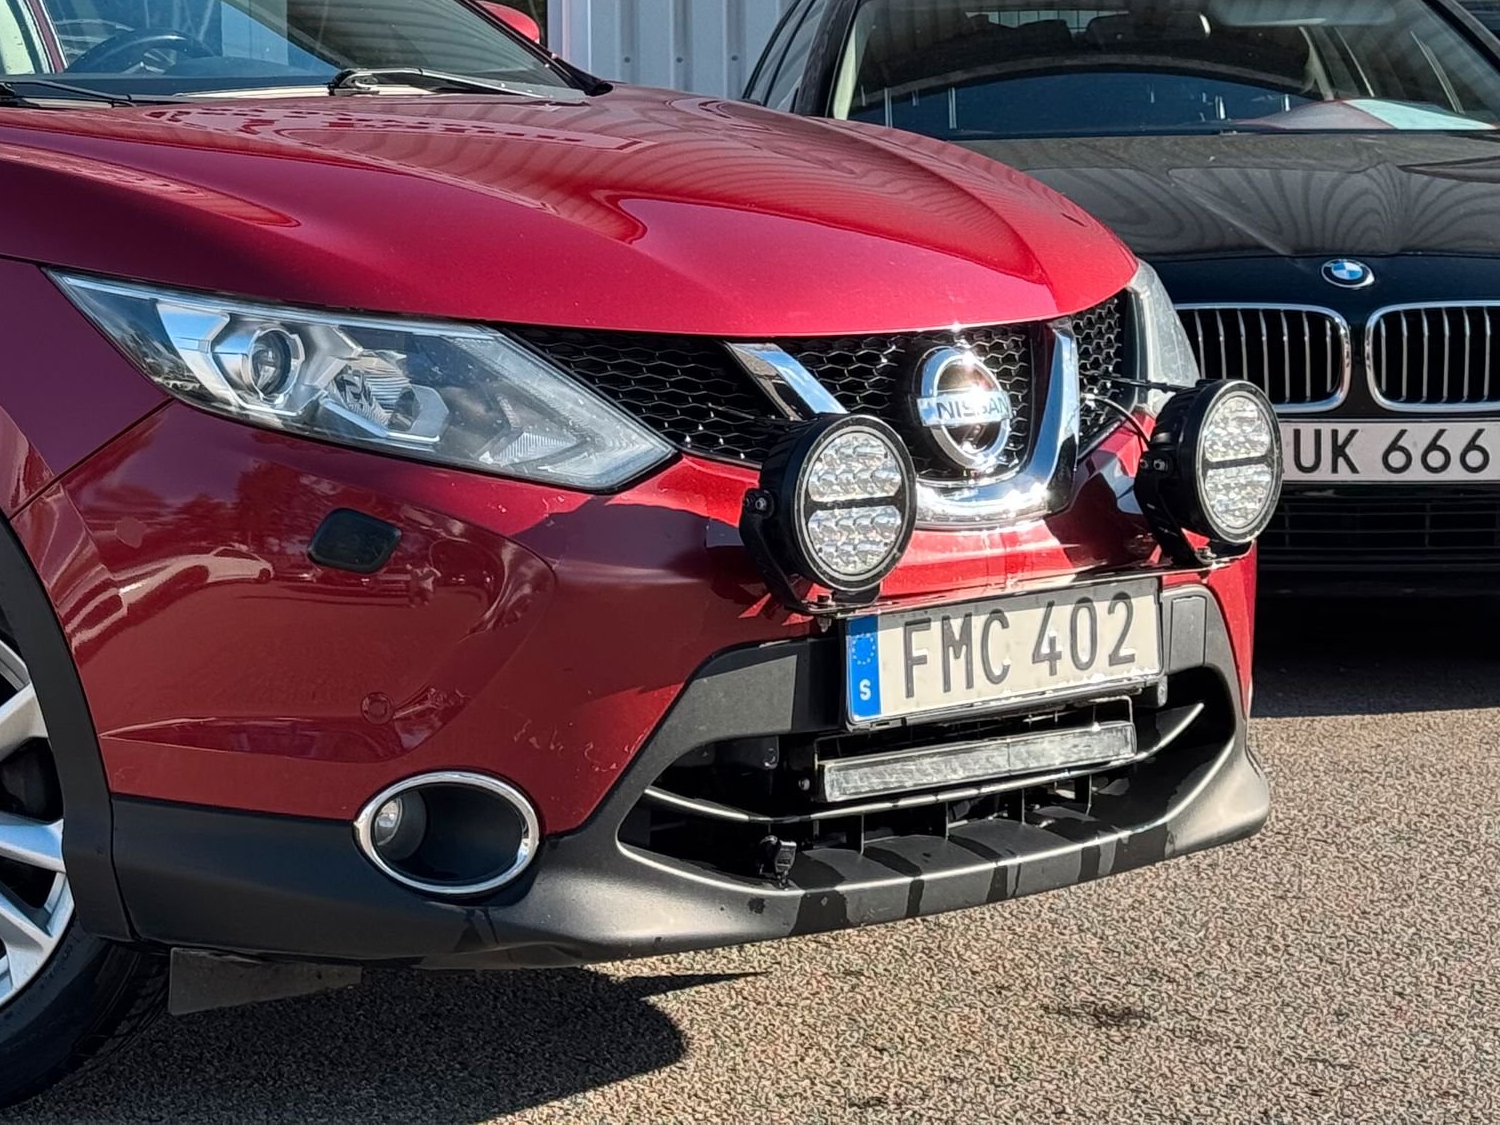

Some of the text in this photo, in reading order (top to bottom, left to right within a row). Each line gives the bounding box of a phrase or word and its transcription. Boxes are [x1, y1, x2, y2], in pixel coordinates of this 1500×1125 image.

[1282, 428, 1491, 474] UK 666
[903, 591, 1136, 699] FMC 402
[859, 679, 872, 702] S
